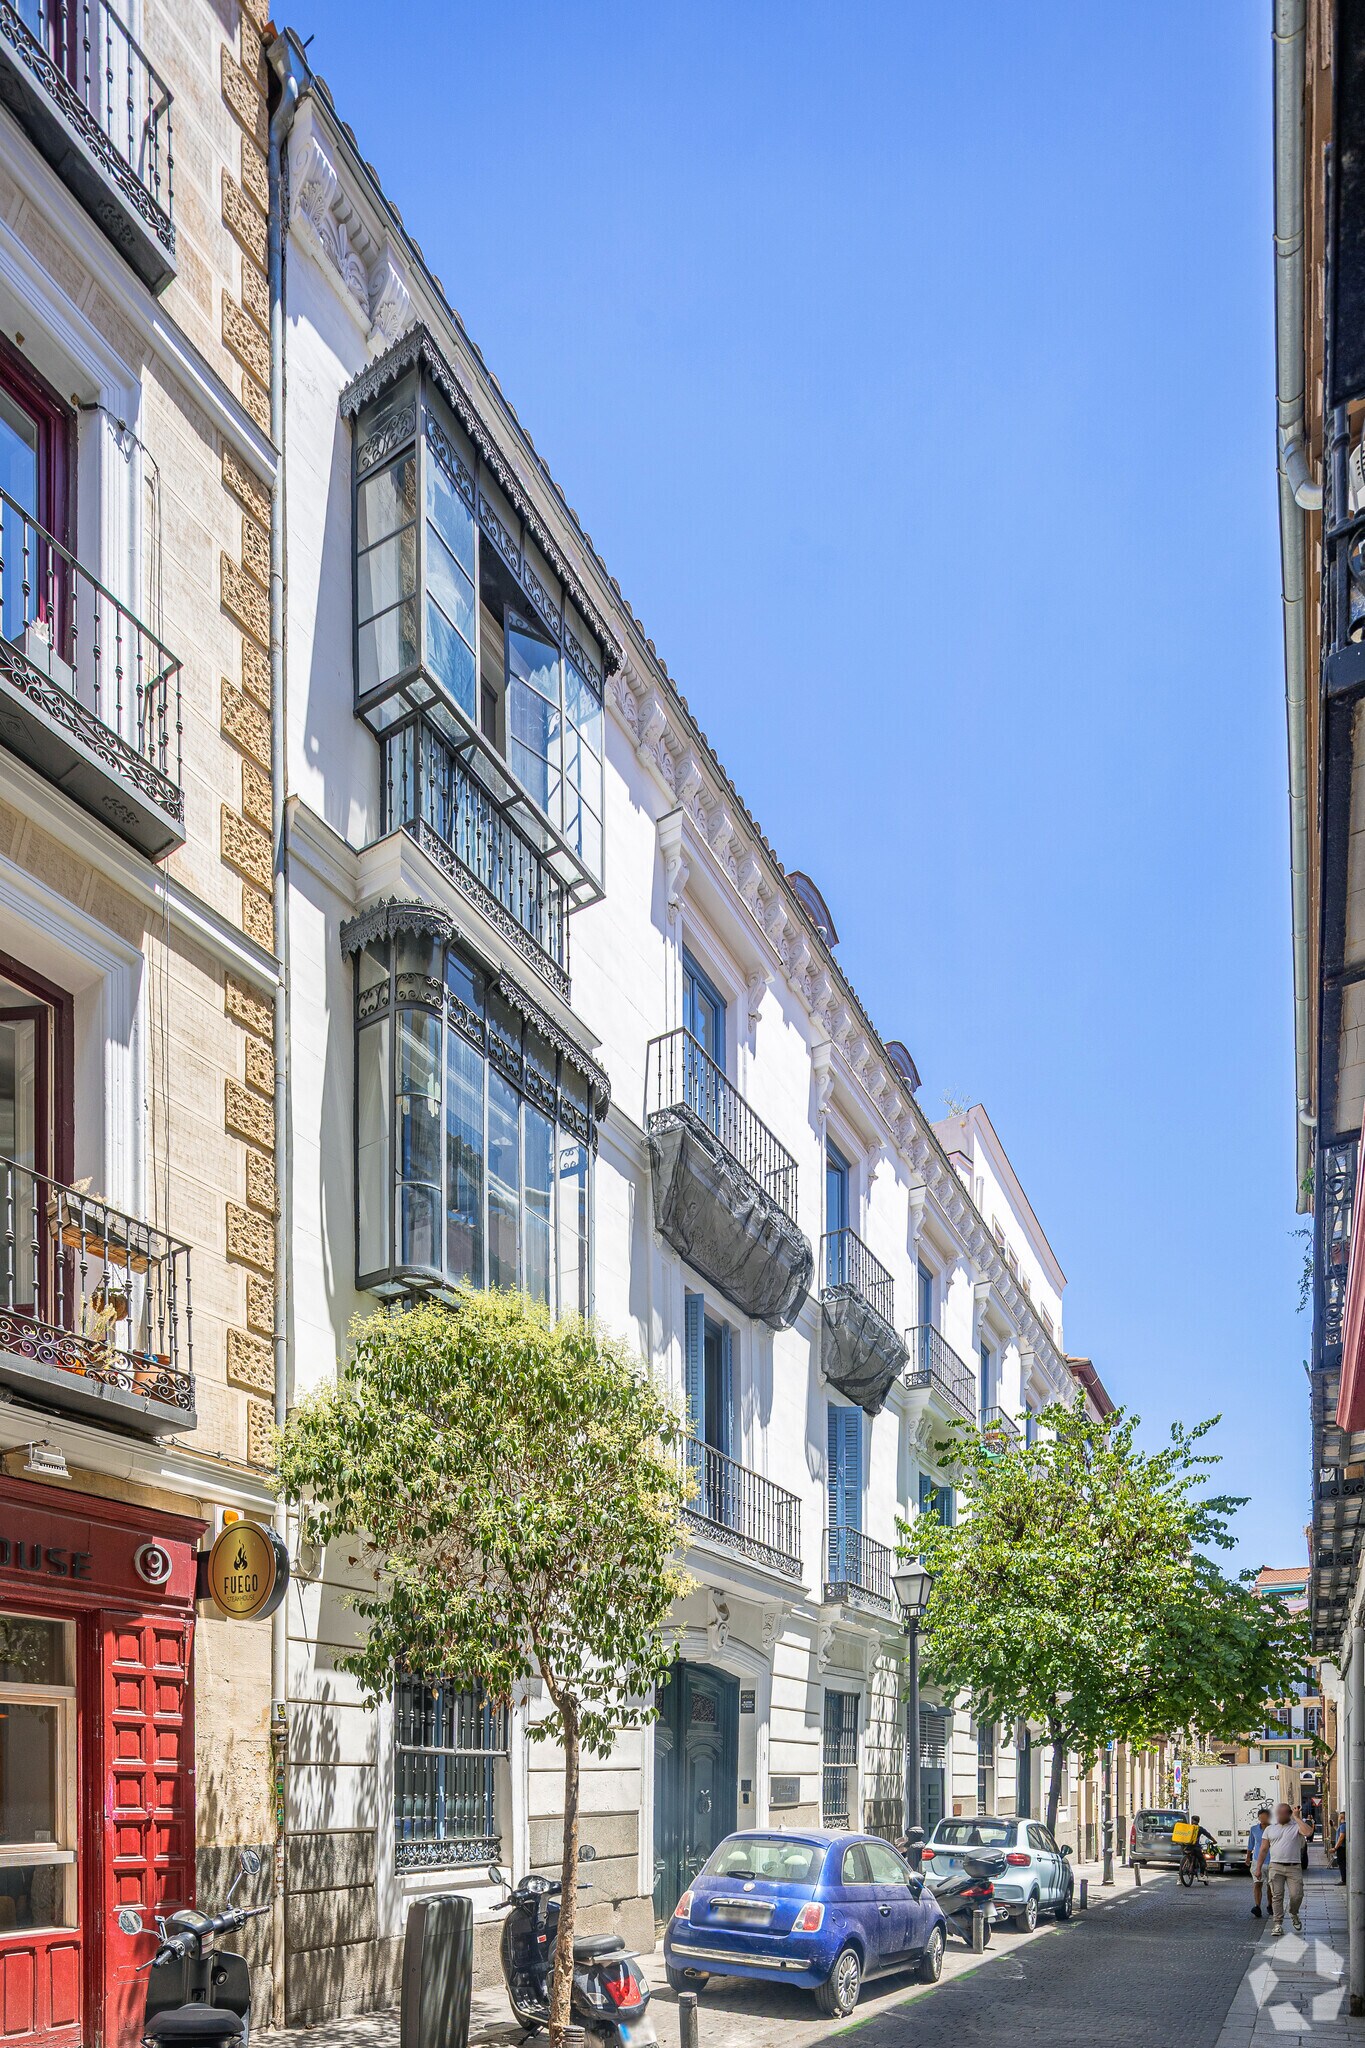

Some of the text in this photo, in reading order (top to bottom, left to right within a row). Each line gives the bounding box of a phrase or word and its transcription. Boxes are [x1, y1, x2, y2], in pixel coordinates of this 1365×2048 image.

[147, 1550, 163, 1577] 9
[224, 1574, 258, 1595] FUEGO
[226, 1594, 256, 1602] STEAKHOUSE
